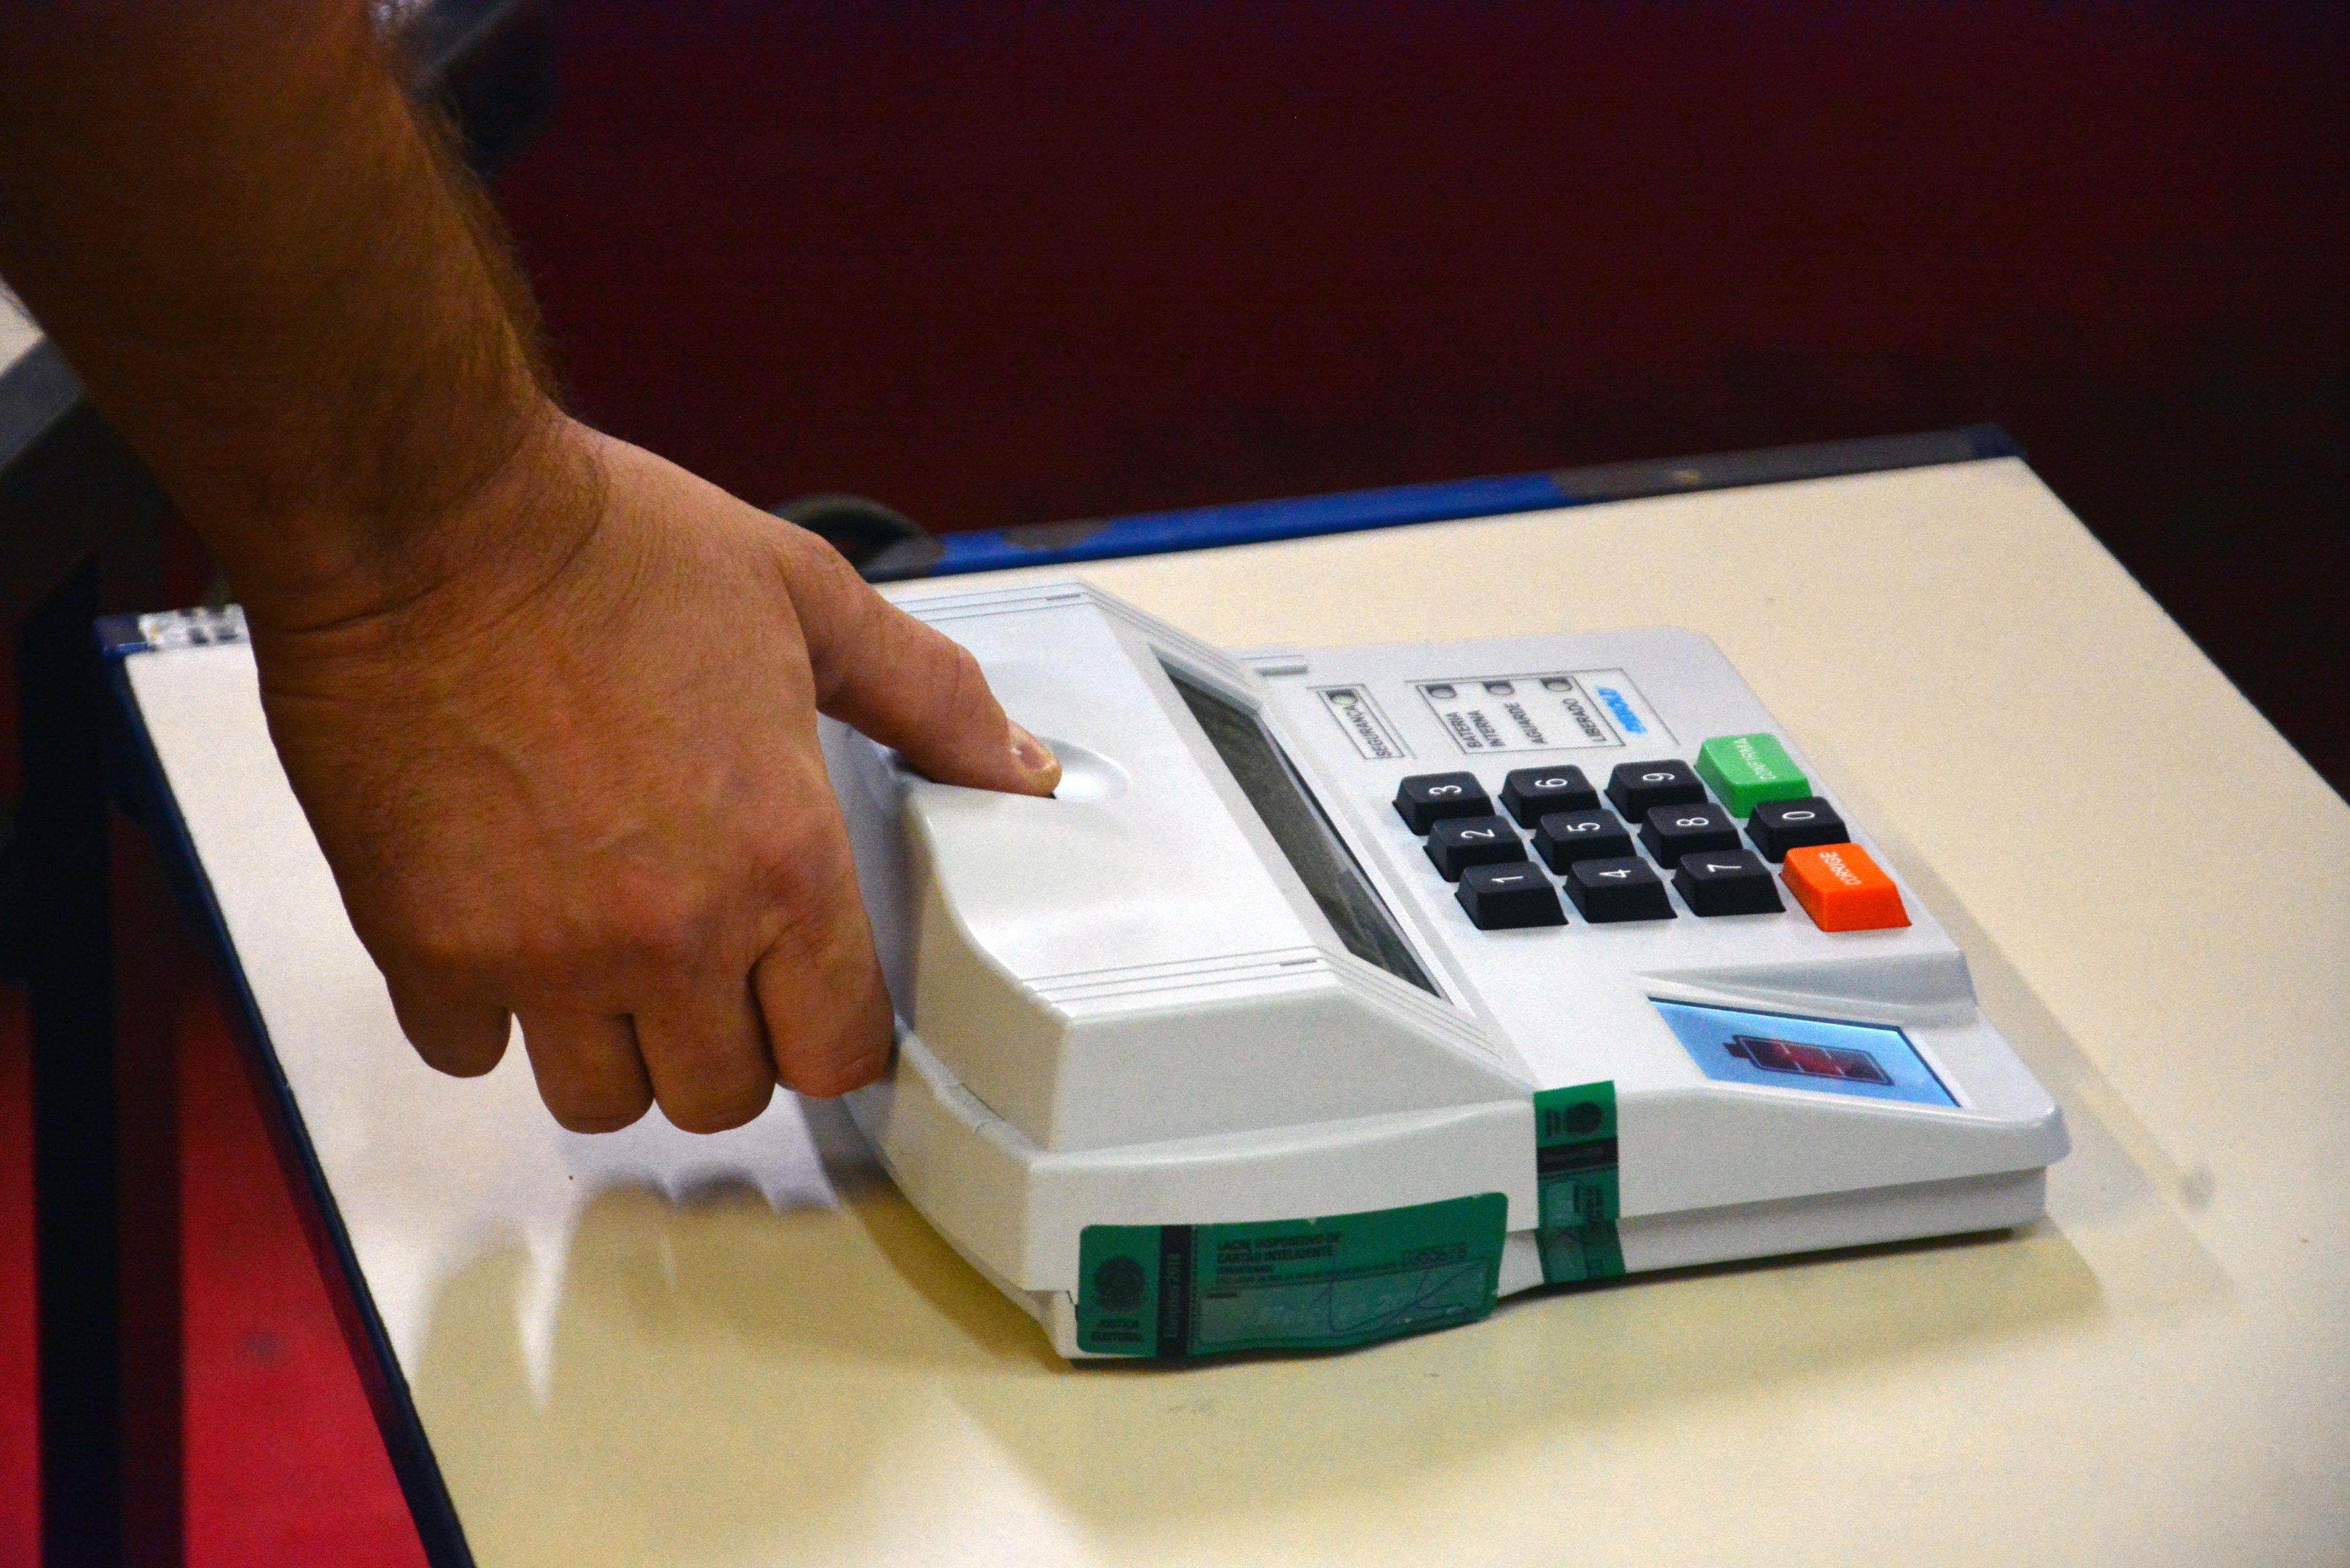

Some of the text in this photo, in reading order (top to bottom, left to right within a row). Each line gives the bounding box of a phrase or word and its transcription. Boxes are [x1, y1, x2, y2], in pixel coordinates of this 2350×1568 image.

[1504, 702, 1548, 744] AGUARDE
[1562, 698, 1607, 742] LIBERADO
[1344, 704, 1393, 759] SEGURANÇA
[1446, 712, 1482, 748] BATERIA
[1466, 709, 1506, 746] INTERNA
[1734, 738, 1776, 780] CONFIRMA
[1534, 777, 1568, 788] 6
[1642, 772, 1676, 783] 9
[1429, 785, 1462, 796] 3
[1782, 810, 1816, 820] 0
[1566, 822, 1601, 833] 5
[1676, 817, 1710, 828] 8
[1461, 828, 1496, 839] 2
[1707, 863, 1742, 873] 7
[1819, 851, 1862, 886] CORRIGE
[1491, 875, 1524, 883] 1
[1599, 869, 1631, 879] 4
